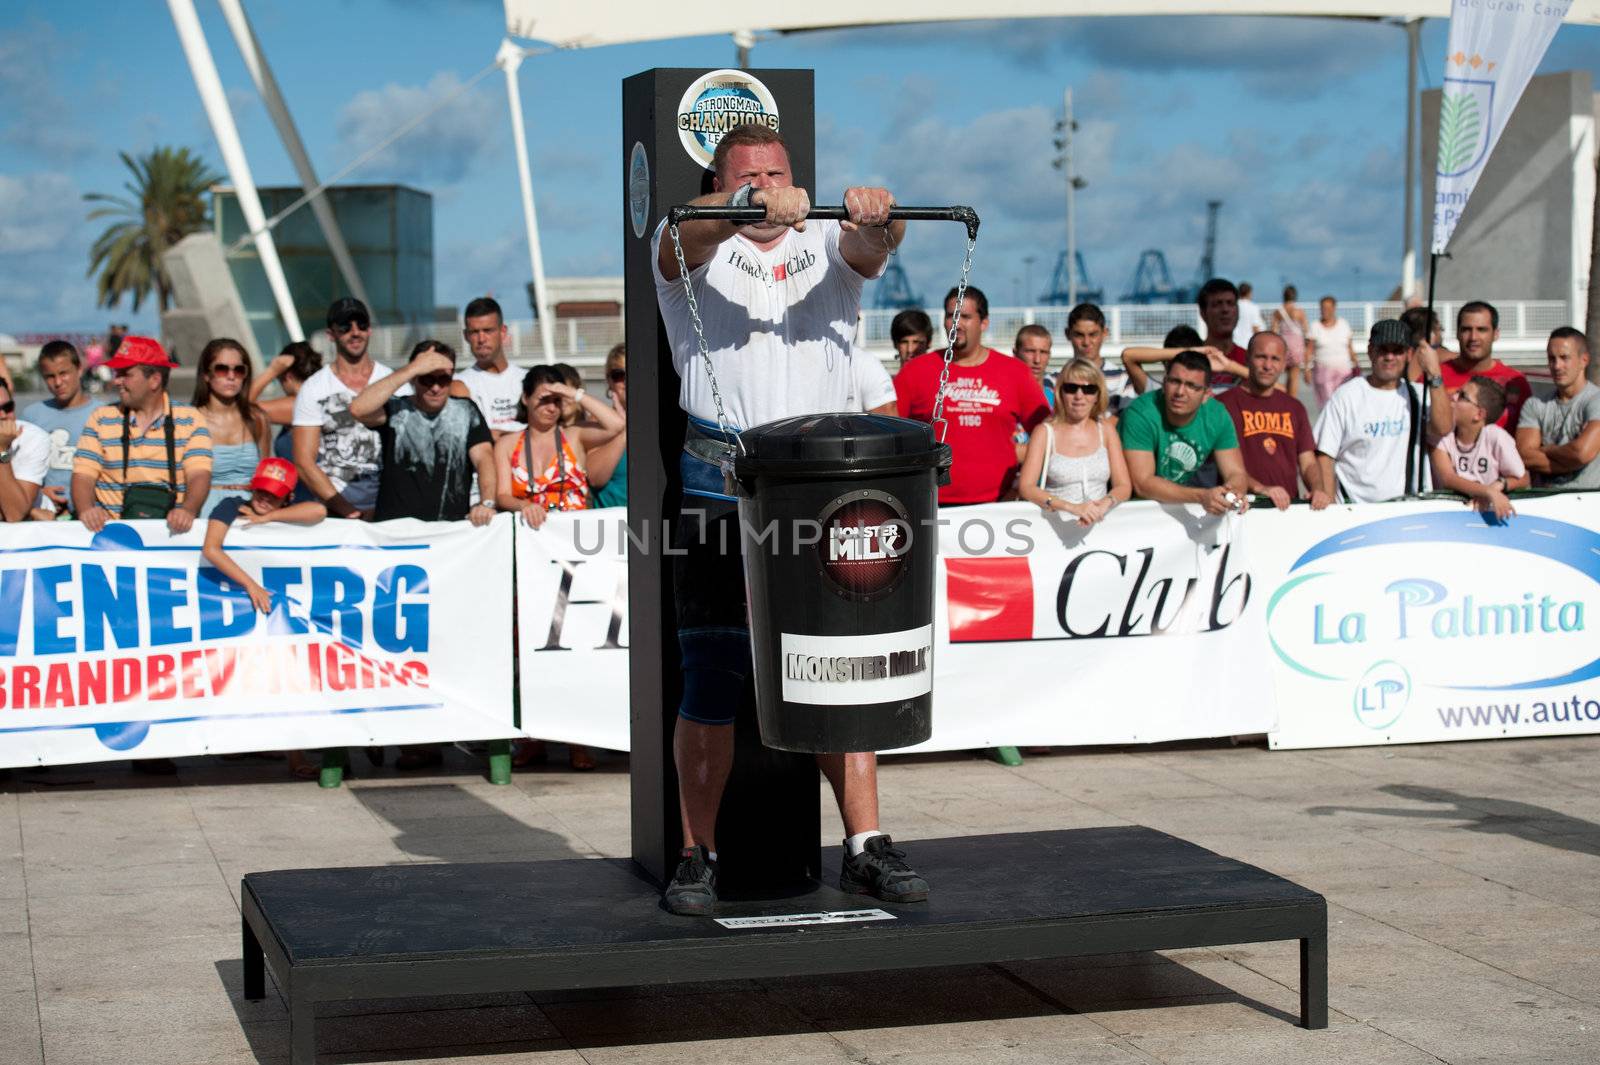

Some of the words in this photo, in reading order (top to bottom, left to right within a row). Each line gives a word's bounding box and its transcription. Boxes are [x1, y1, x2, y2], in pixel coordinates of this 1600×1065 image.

[697, 97, 760, 112] STRONGMAN
[679, 111, 779, 133] CHAMPIONS
[786, 249, 816, 276] Club
[1241, 410, 1295, 435] ROMA
[829, 524, 898, 539] MONSTER
[829, 536, 898, 561] MILK
[1056, 543, 1252, 639] Club
[1314, 603, 1367, 645] La
[1384, 577, 1586, 641] Palmita
[787, 653, 888, 683] MONSTER
[889, 648, 929, 678] MILK
[1436, 694, 1600, 729] www.auto
